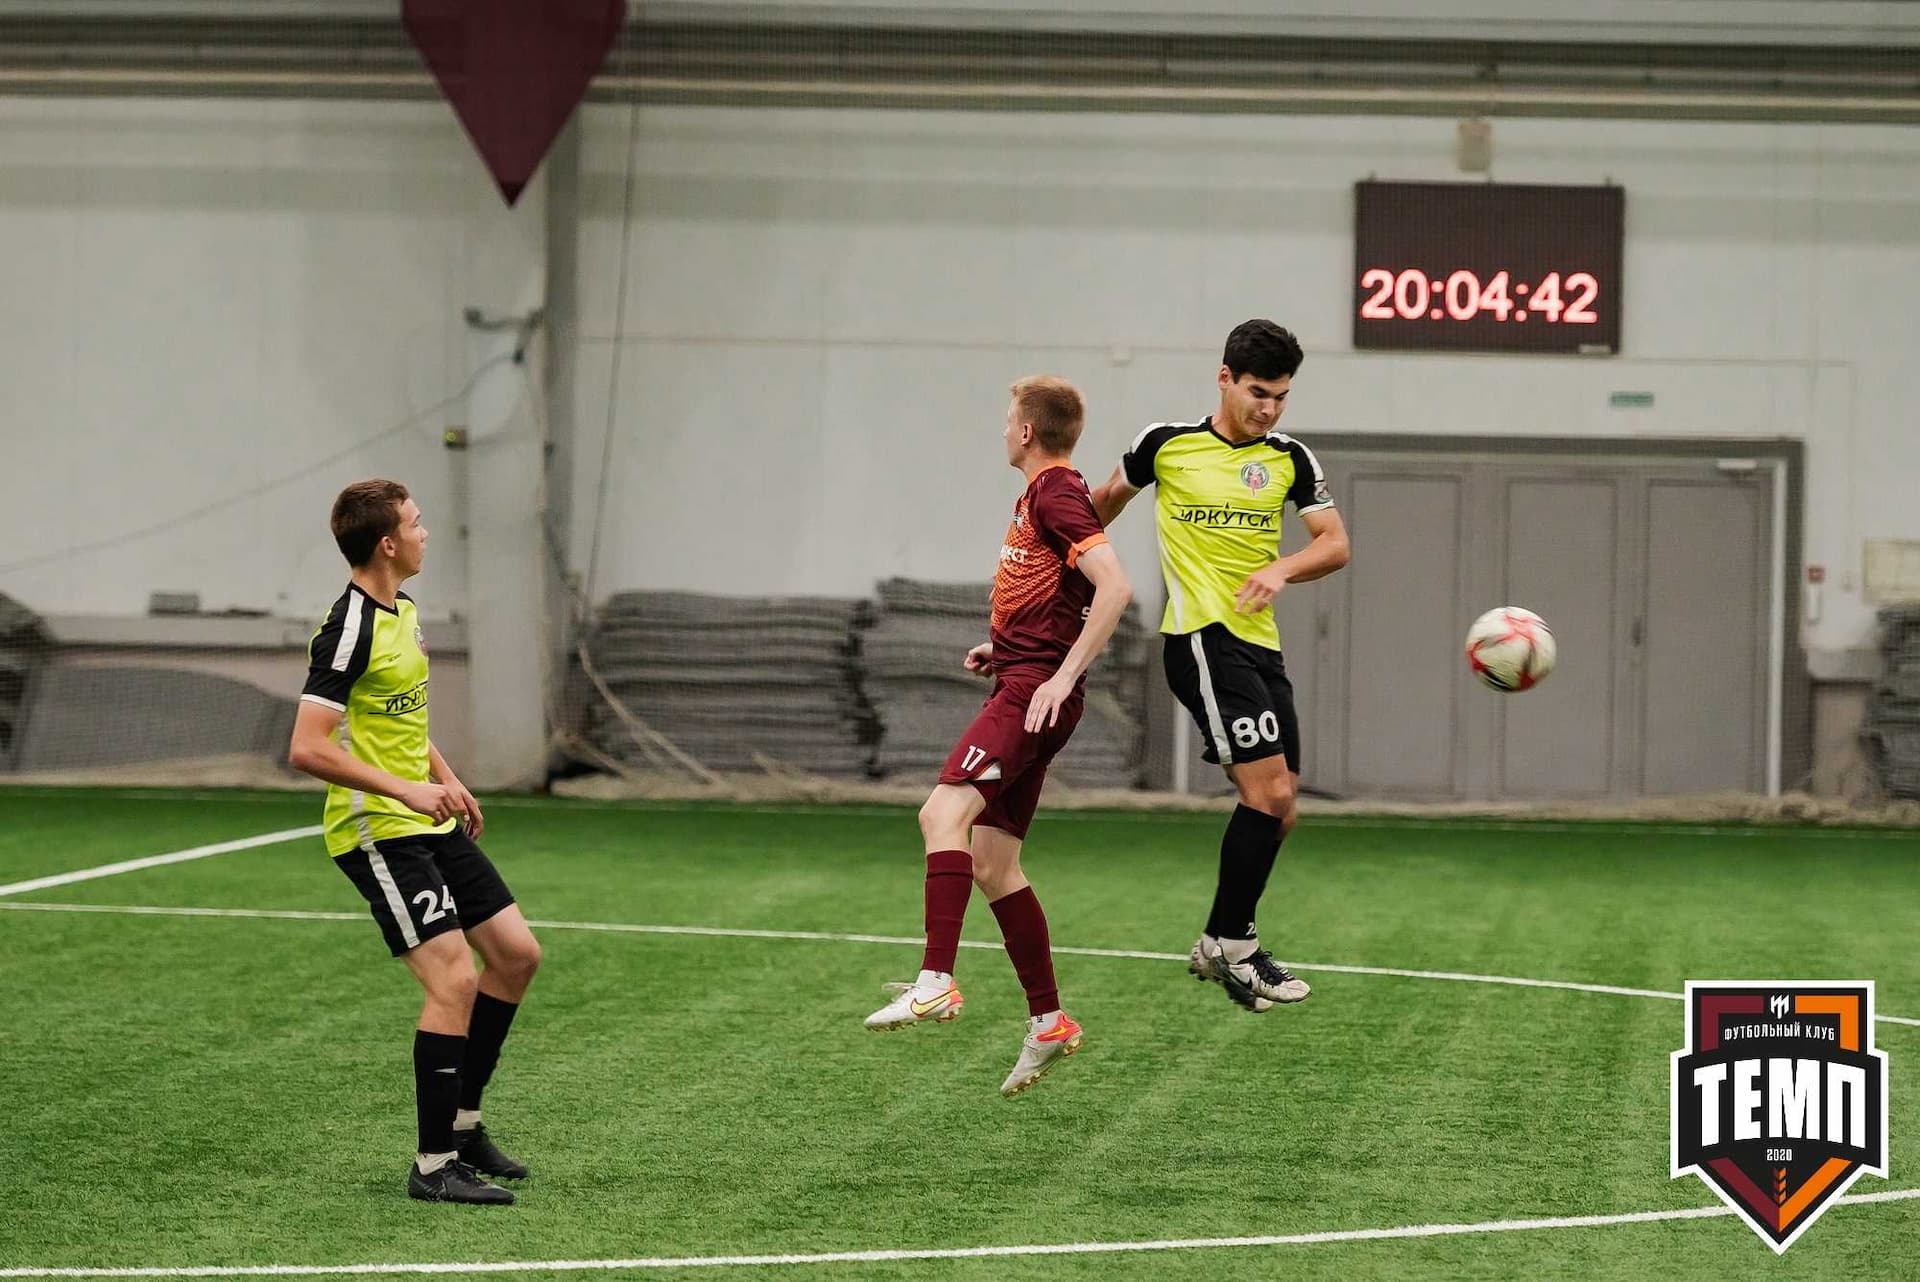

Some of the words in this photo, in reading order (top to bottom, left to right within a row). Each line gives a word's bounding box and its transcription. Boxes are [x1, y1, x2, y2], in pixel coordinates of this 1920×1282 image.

[1359, 267, 1599, 324] 20:04:42
[1181, 508, 1273, 528] ИРКУТСК
[1231, 710, 1279, 749] 80
[960, 744, 987, 772] 17
[412, 884, 458, 925] 24
